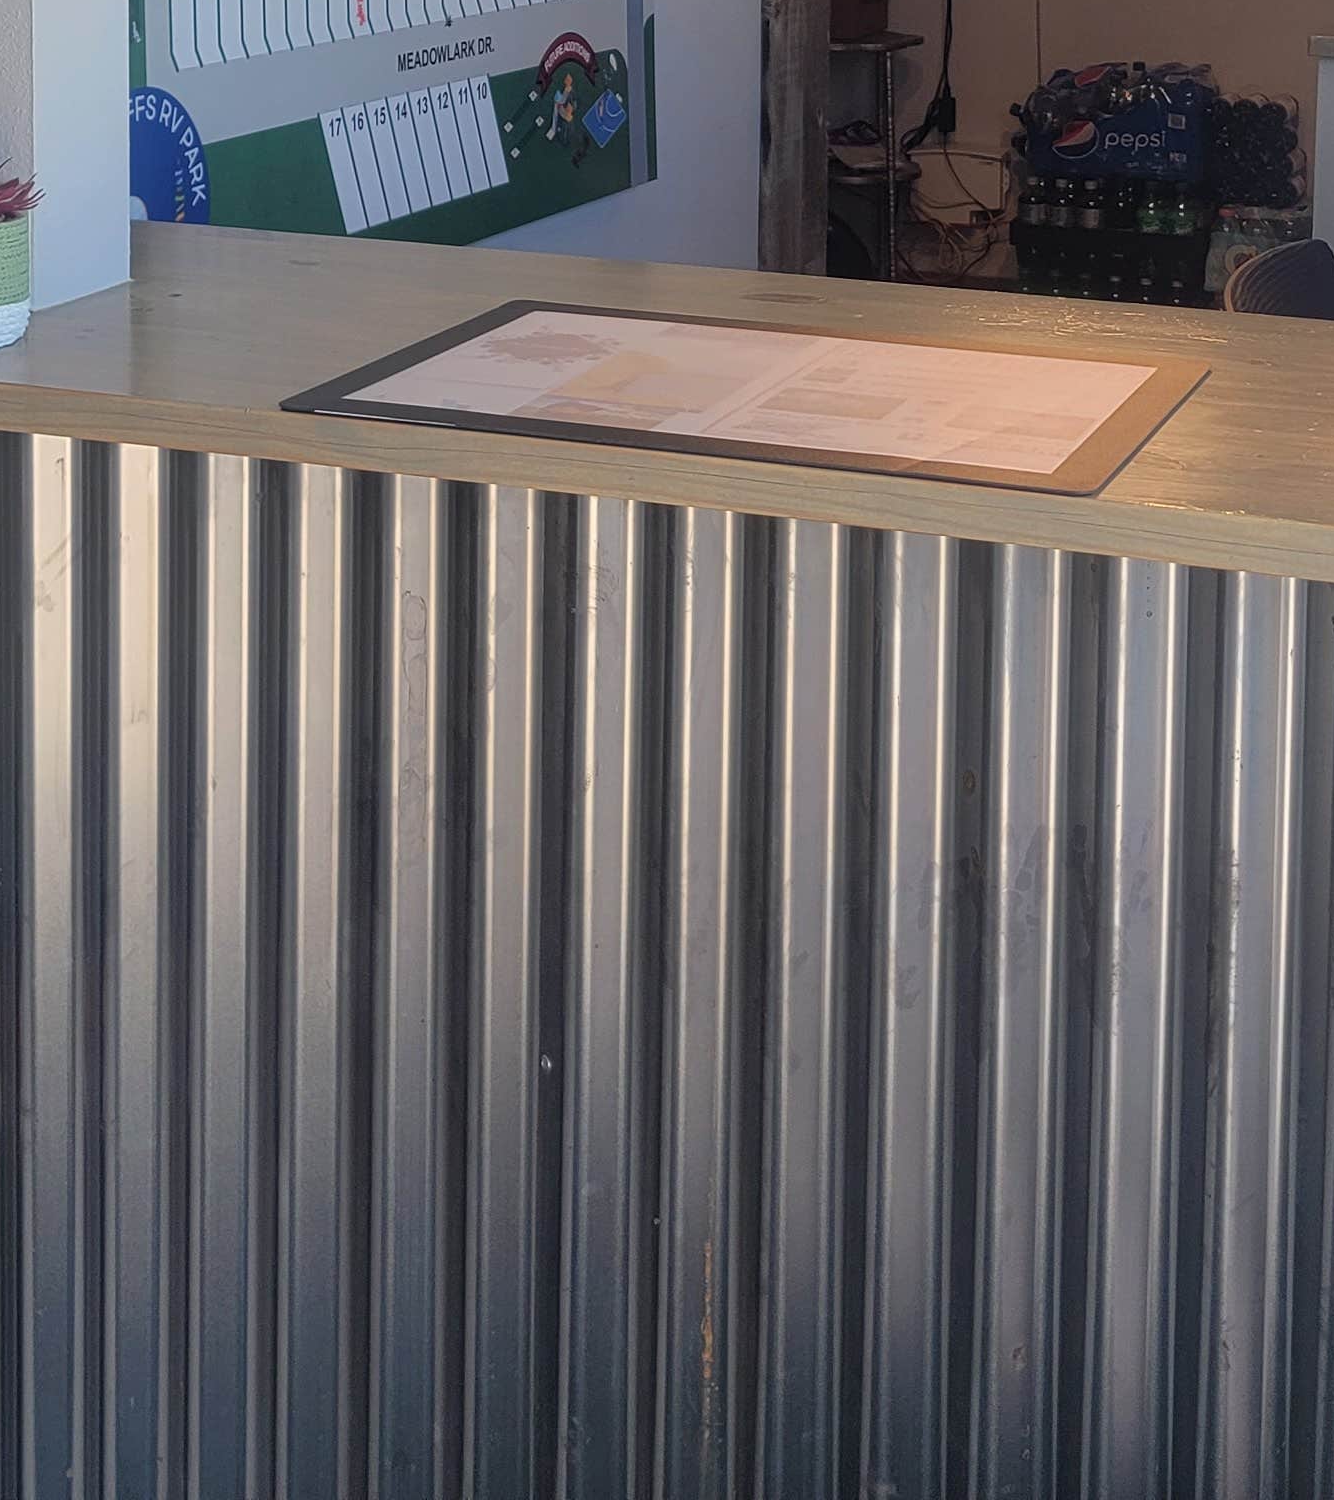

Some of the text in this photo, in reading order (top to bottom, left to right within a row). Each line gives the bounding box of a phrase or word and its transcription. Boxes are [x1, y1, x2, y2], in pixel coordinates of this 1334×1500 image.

[397, 36, 495, 72] MEADOWLARK DR.
[329, 82, 487, 137] 17 16 15 14 13 12 11 10
[159, 98, 184, 133] RV
[179, 126, 206, 206] PARK
[1104, 130, 1166, 152] pepsi
